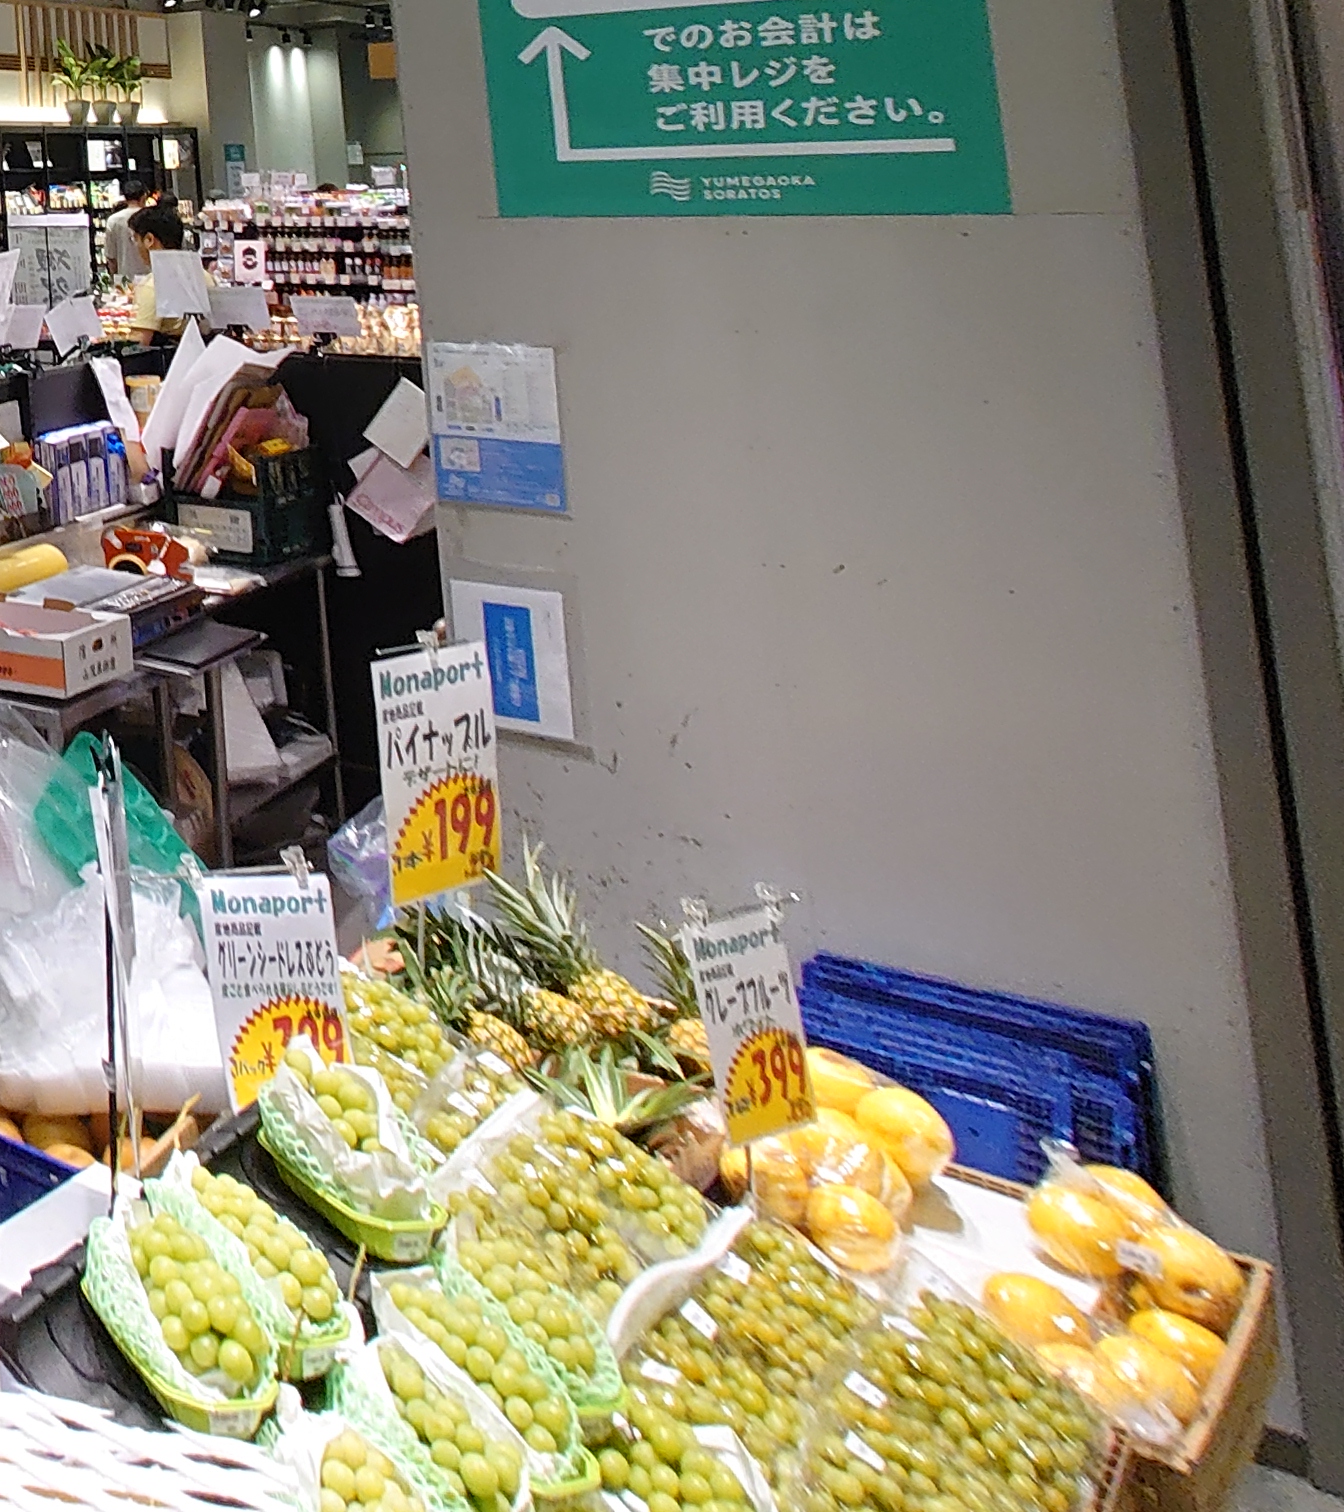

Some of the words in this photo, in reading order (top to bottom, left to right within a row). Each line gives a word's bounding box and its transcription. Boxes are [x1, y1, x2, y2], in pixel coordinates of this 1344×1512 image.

[643, 10, 880, 51] でのお会計は
[649, 55, 836, 92] 集中レジを
[656, 94, 946, 132] ご利用ください。
[699, 175, 816, 188] YUMEGAOKA
[703, 188, 782, 201] SORATOS
[379, 651, 484, 700] Monaport
[386, 708, 492, 769] パイナップル
[211, 889, 328, 917] Monaport
[218, 940, 335, 978] グリーンシードレスぶどう
